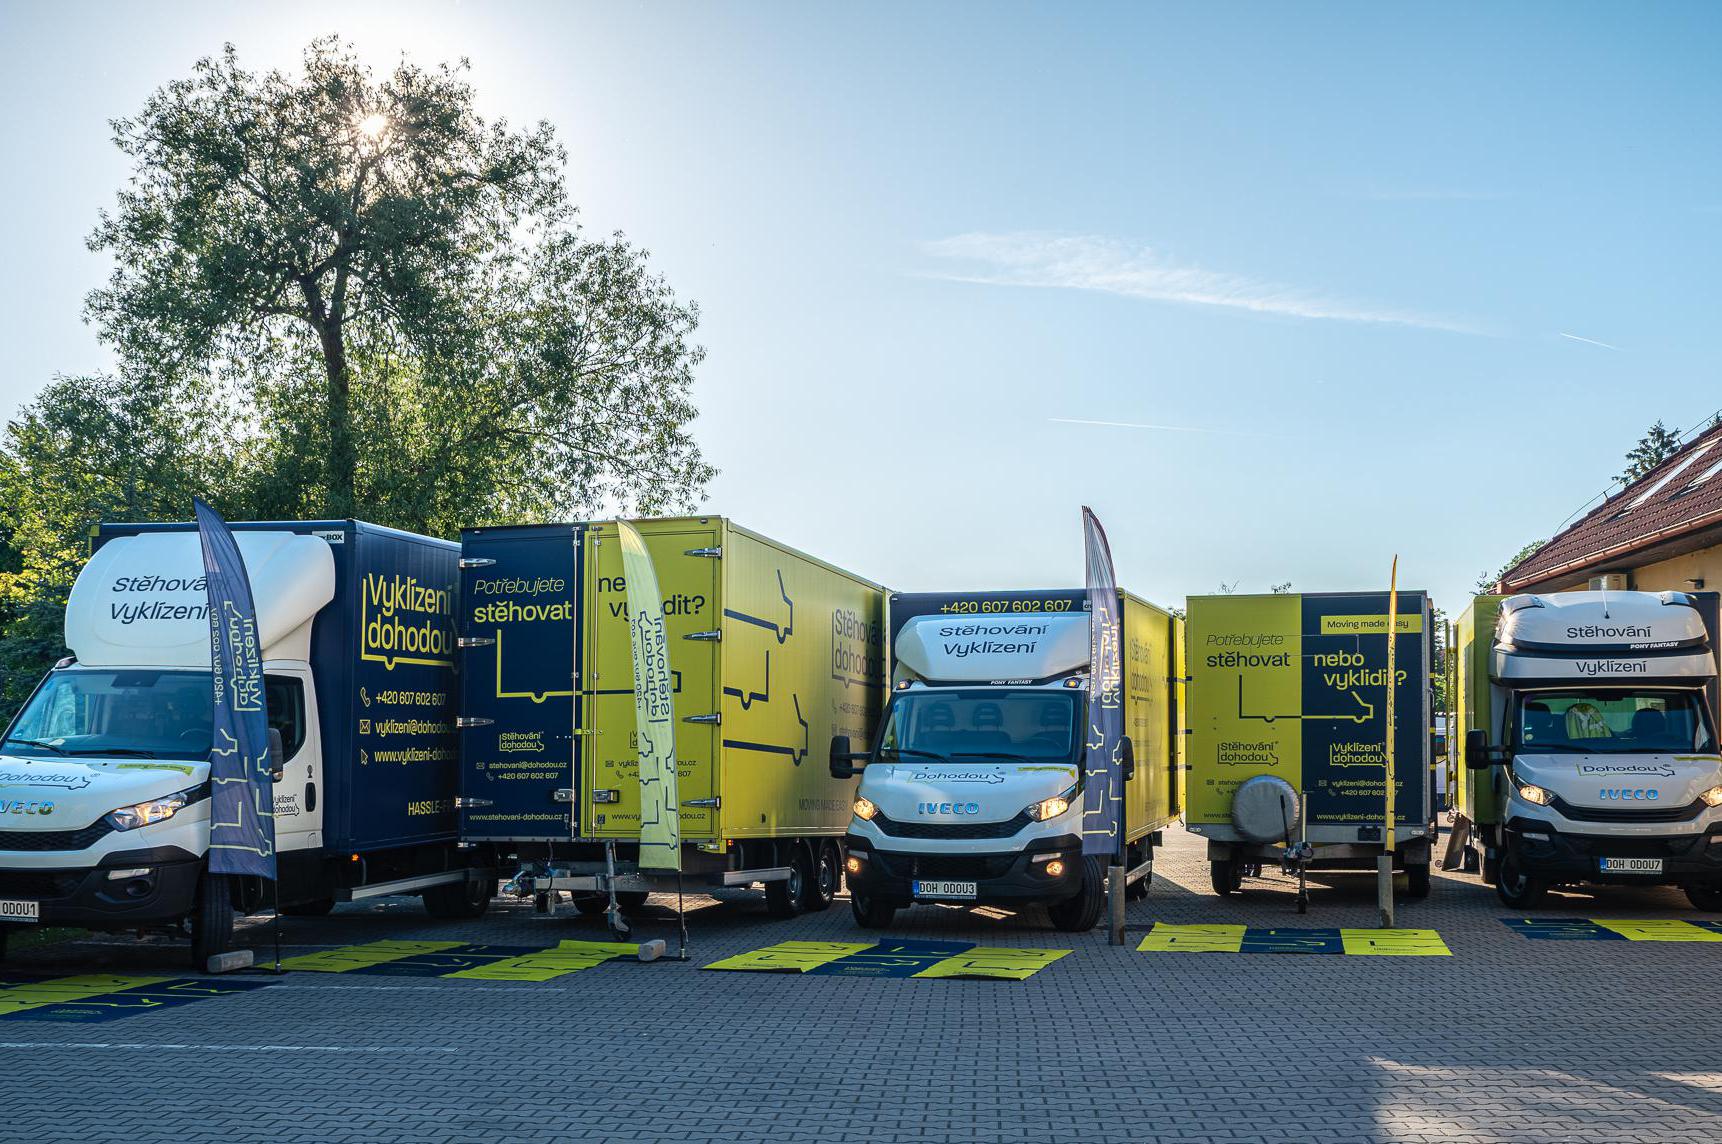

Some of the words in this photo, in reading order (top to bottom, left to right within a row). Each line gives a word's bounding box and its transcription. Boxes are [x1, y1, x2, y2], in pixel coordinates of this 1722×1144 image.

[474, 577, 565, 597] Potřebujete
[369, 572, 453, 617] Vyklízení
[111, 601, 211, 624] Vyklízení
[474, 600, 573, 623] stěhovat
[940, 601, 978, 614] +420
[982, 601, 1009, 613] 607
[1012, 600, 1041, 612] 602
[1045, 600, 1072, 612] 607
[939, 624, 1049, 637] Stěhování
[1327, 620, 1359, 630] Moving
[1361, 619, 1385, 628] made
[368, 613, 453, 655] dohodou
[1566, 625, 1652, 639] Stěhování
[1206, 633, 1284, 649] Potřebujete
[1650, 641, 1679, 649] FANTASY
[944, 641, 1038, 658] Vyklízení
[1206, 651, 1290, 668] stěhovat
[1314, 649, 1364, 667] nebo
[1576, 660, 1647, 676] Vyklízení
[1323, 669, 1408, 691] vyklidi?
[376, 691, 398, 705] +420
[400, 691, 413, 705] 607
[416, 692, 430, 706] 602
[432, 693, 447, 706] 607
[502, 732, 541, 741] Stěhování
[502, 740, 537, 749] dohodou
[1220, 741, 1274, 751] Stěhování
[1332, 742, 1382, 754] Vyklízení
[1220, 752, 1269, 762] dohodou
[1332, 753, 1383, 763] dohodou
[1583, 765, 1657, 773] Dohodou
[498, 772, 516, 780] +420
[517, 772, 529, 780] 607
[530, 772, 544, 780] 602
[545, 772, 560, 780] 607
[914, 772, 990, 780] Dohodou
[1600, 788, 1659, 800] IVECO
[918, 802, 980, 815] IVECO
